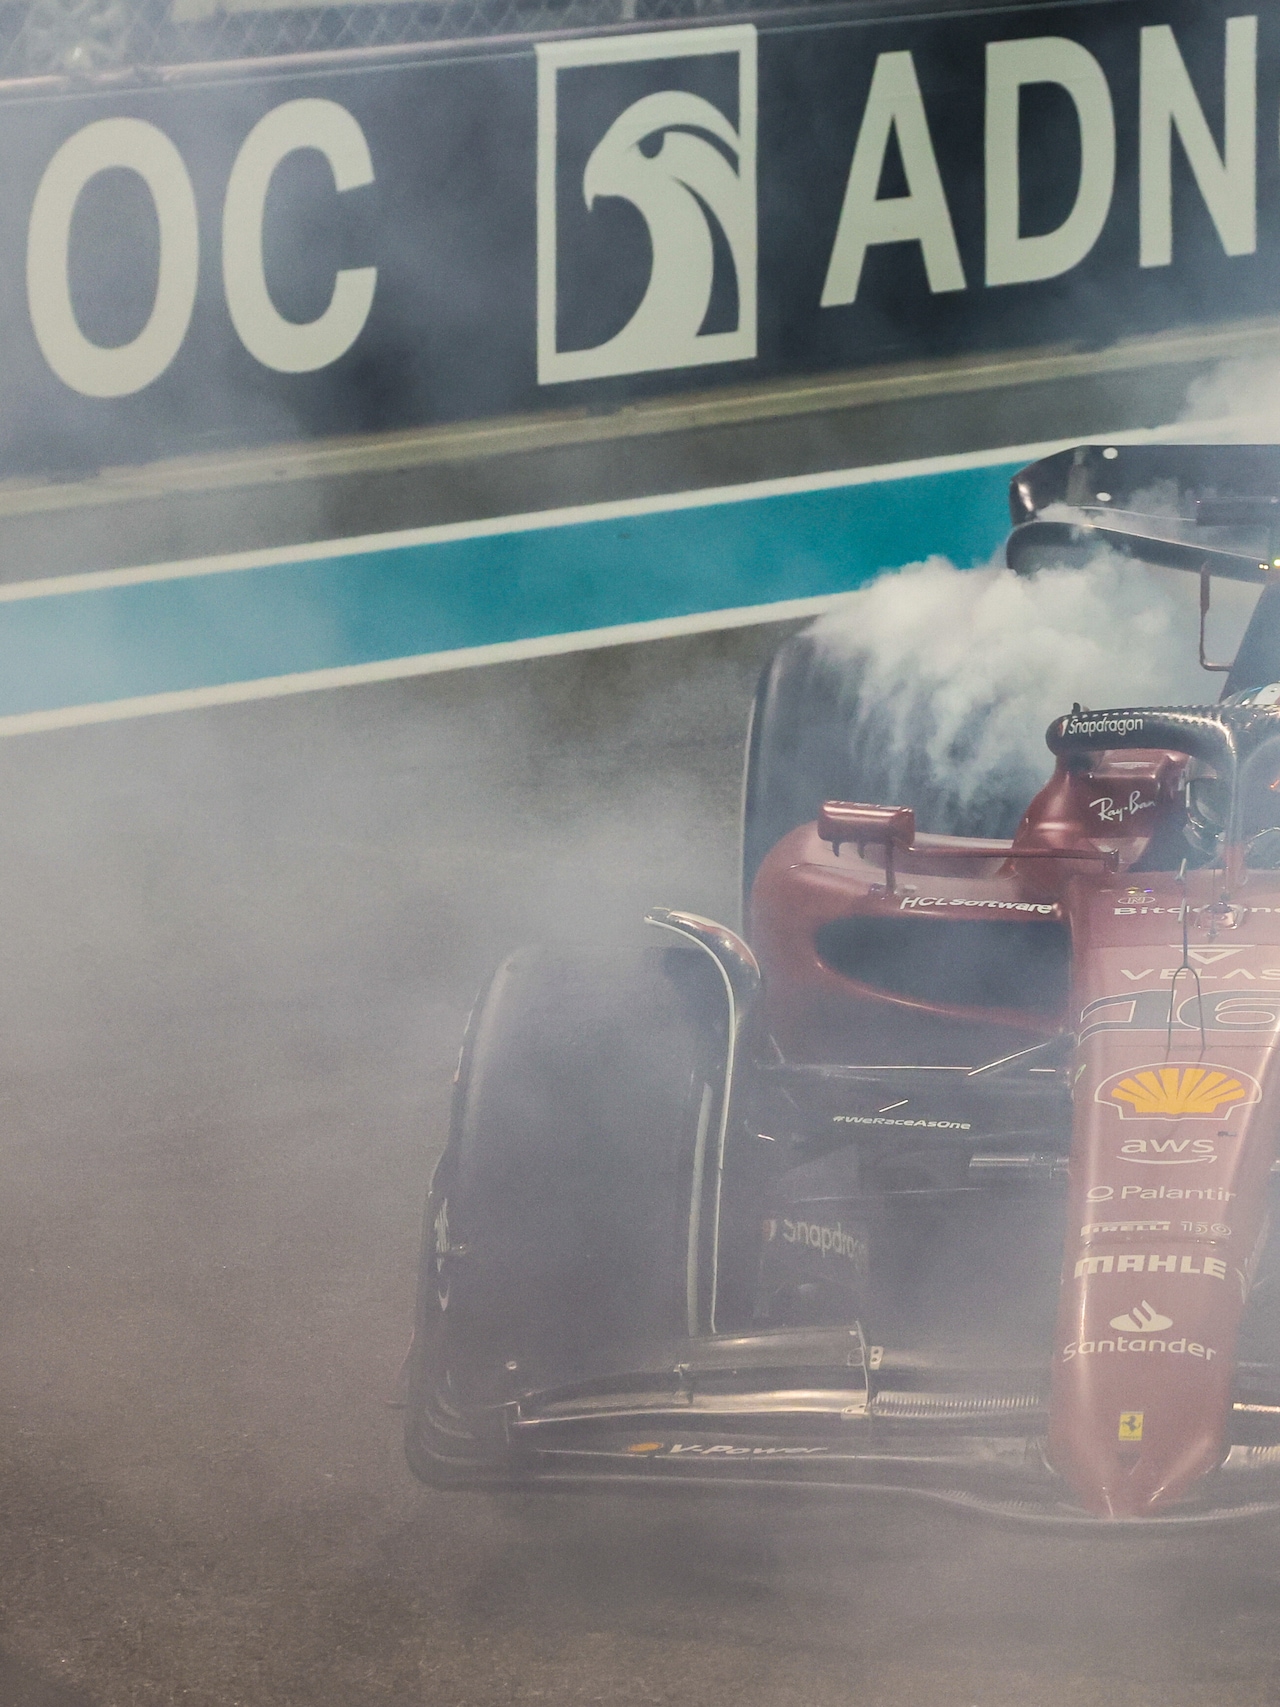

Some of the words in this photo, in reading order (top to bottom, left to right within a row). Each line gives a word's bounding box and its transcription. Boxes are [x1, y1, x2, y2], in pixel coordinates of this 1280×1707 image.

[26, 98, 378, 398] OC
[1067, 716, 1144, 738] Snapdragon
[1088, 790, 1156, 822] Ray-Ban
[832, 1114, 972, 1131] #WeRaceAsOne
[1120, 1138, 1215, 1153] aws
[1120, 1185, 1237, 1203] Palantir
[1073, 1254, 1228, 1280] MAHLE
[1062, 1336, 1217, 1363] Santander
[669, 1442, 828, 1456] V-Power
